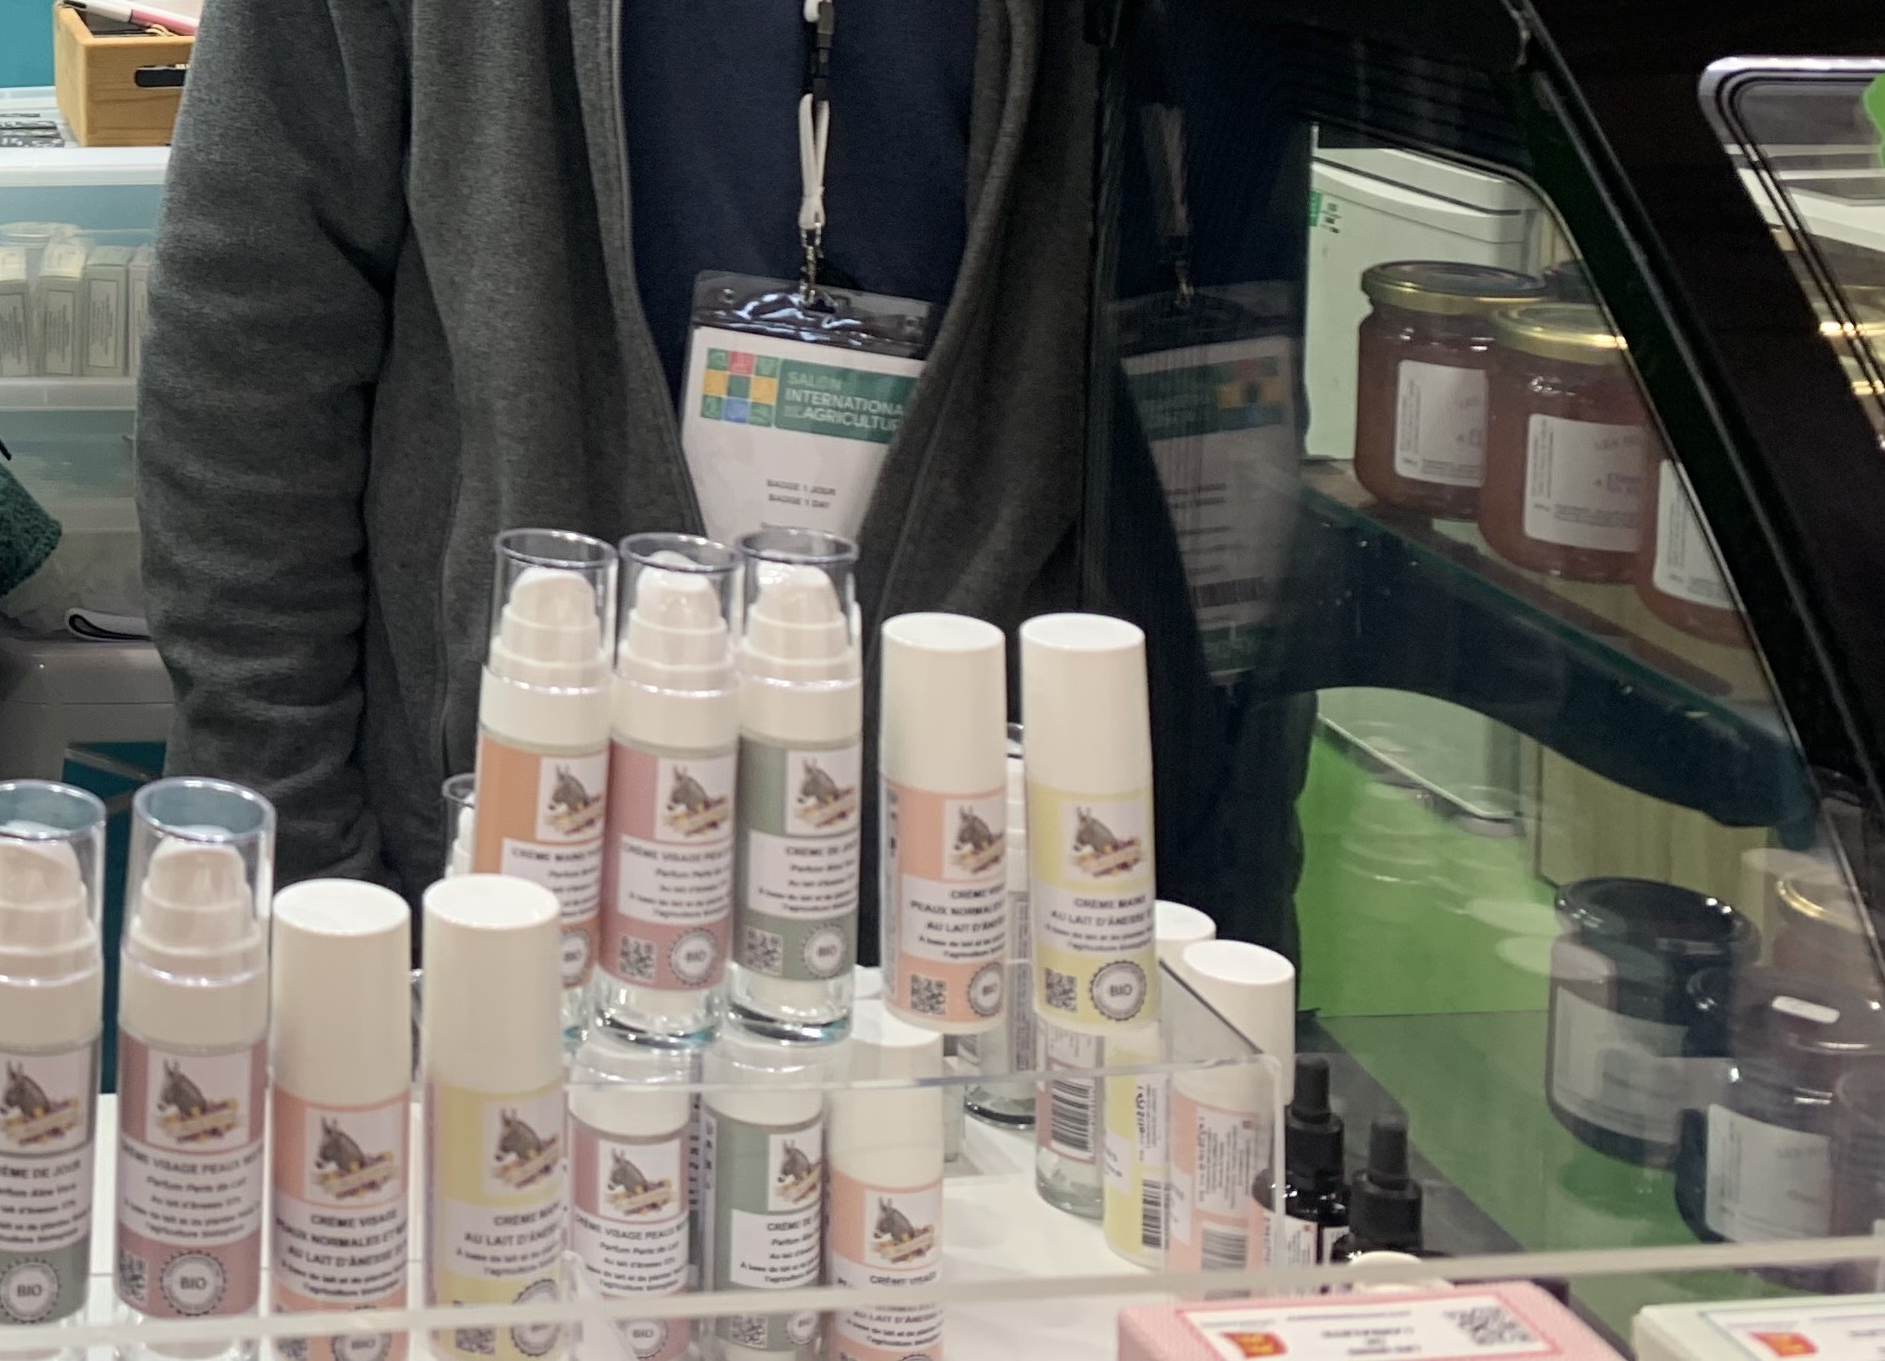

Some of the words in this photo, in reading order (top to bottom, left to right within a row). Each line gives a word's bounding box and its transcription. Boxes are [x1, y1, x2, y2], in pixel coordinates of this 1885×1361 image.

[33, 1168, 49, 1179] DE
[606, 1228, 642, 1240] VISAGE
[179, 1275, 207, 1293] BIO
[16, 1283, 42, 1299] BIO
[633, 1329, 654, 1338] BIO
